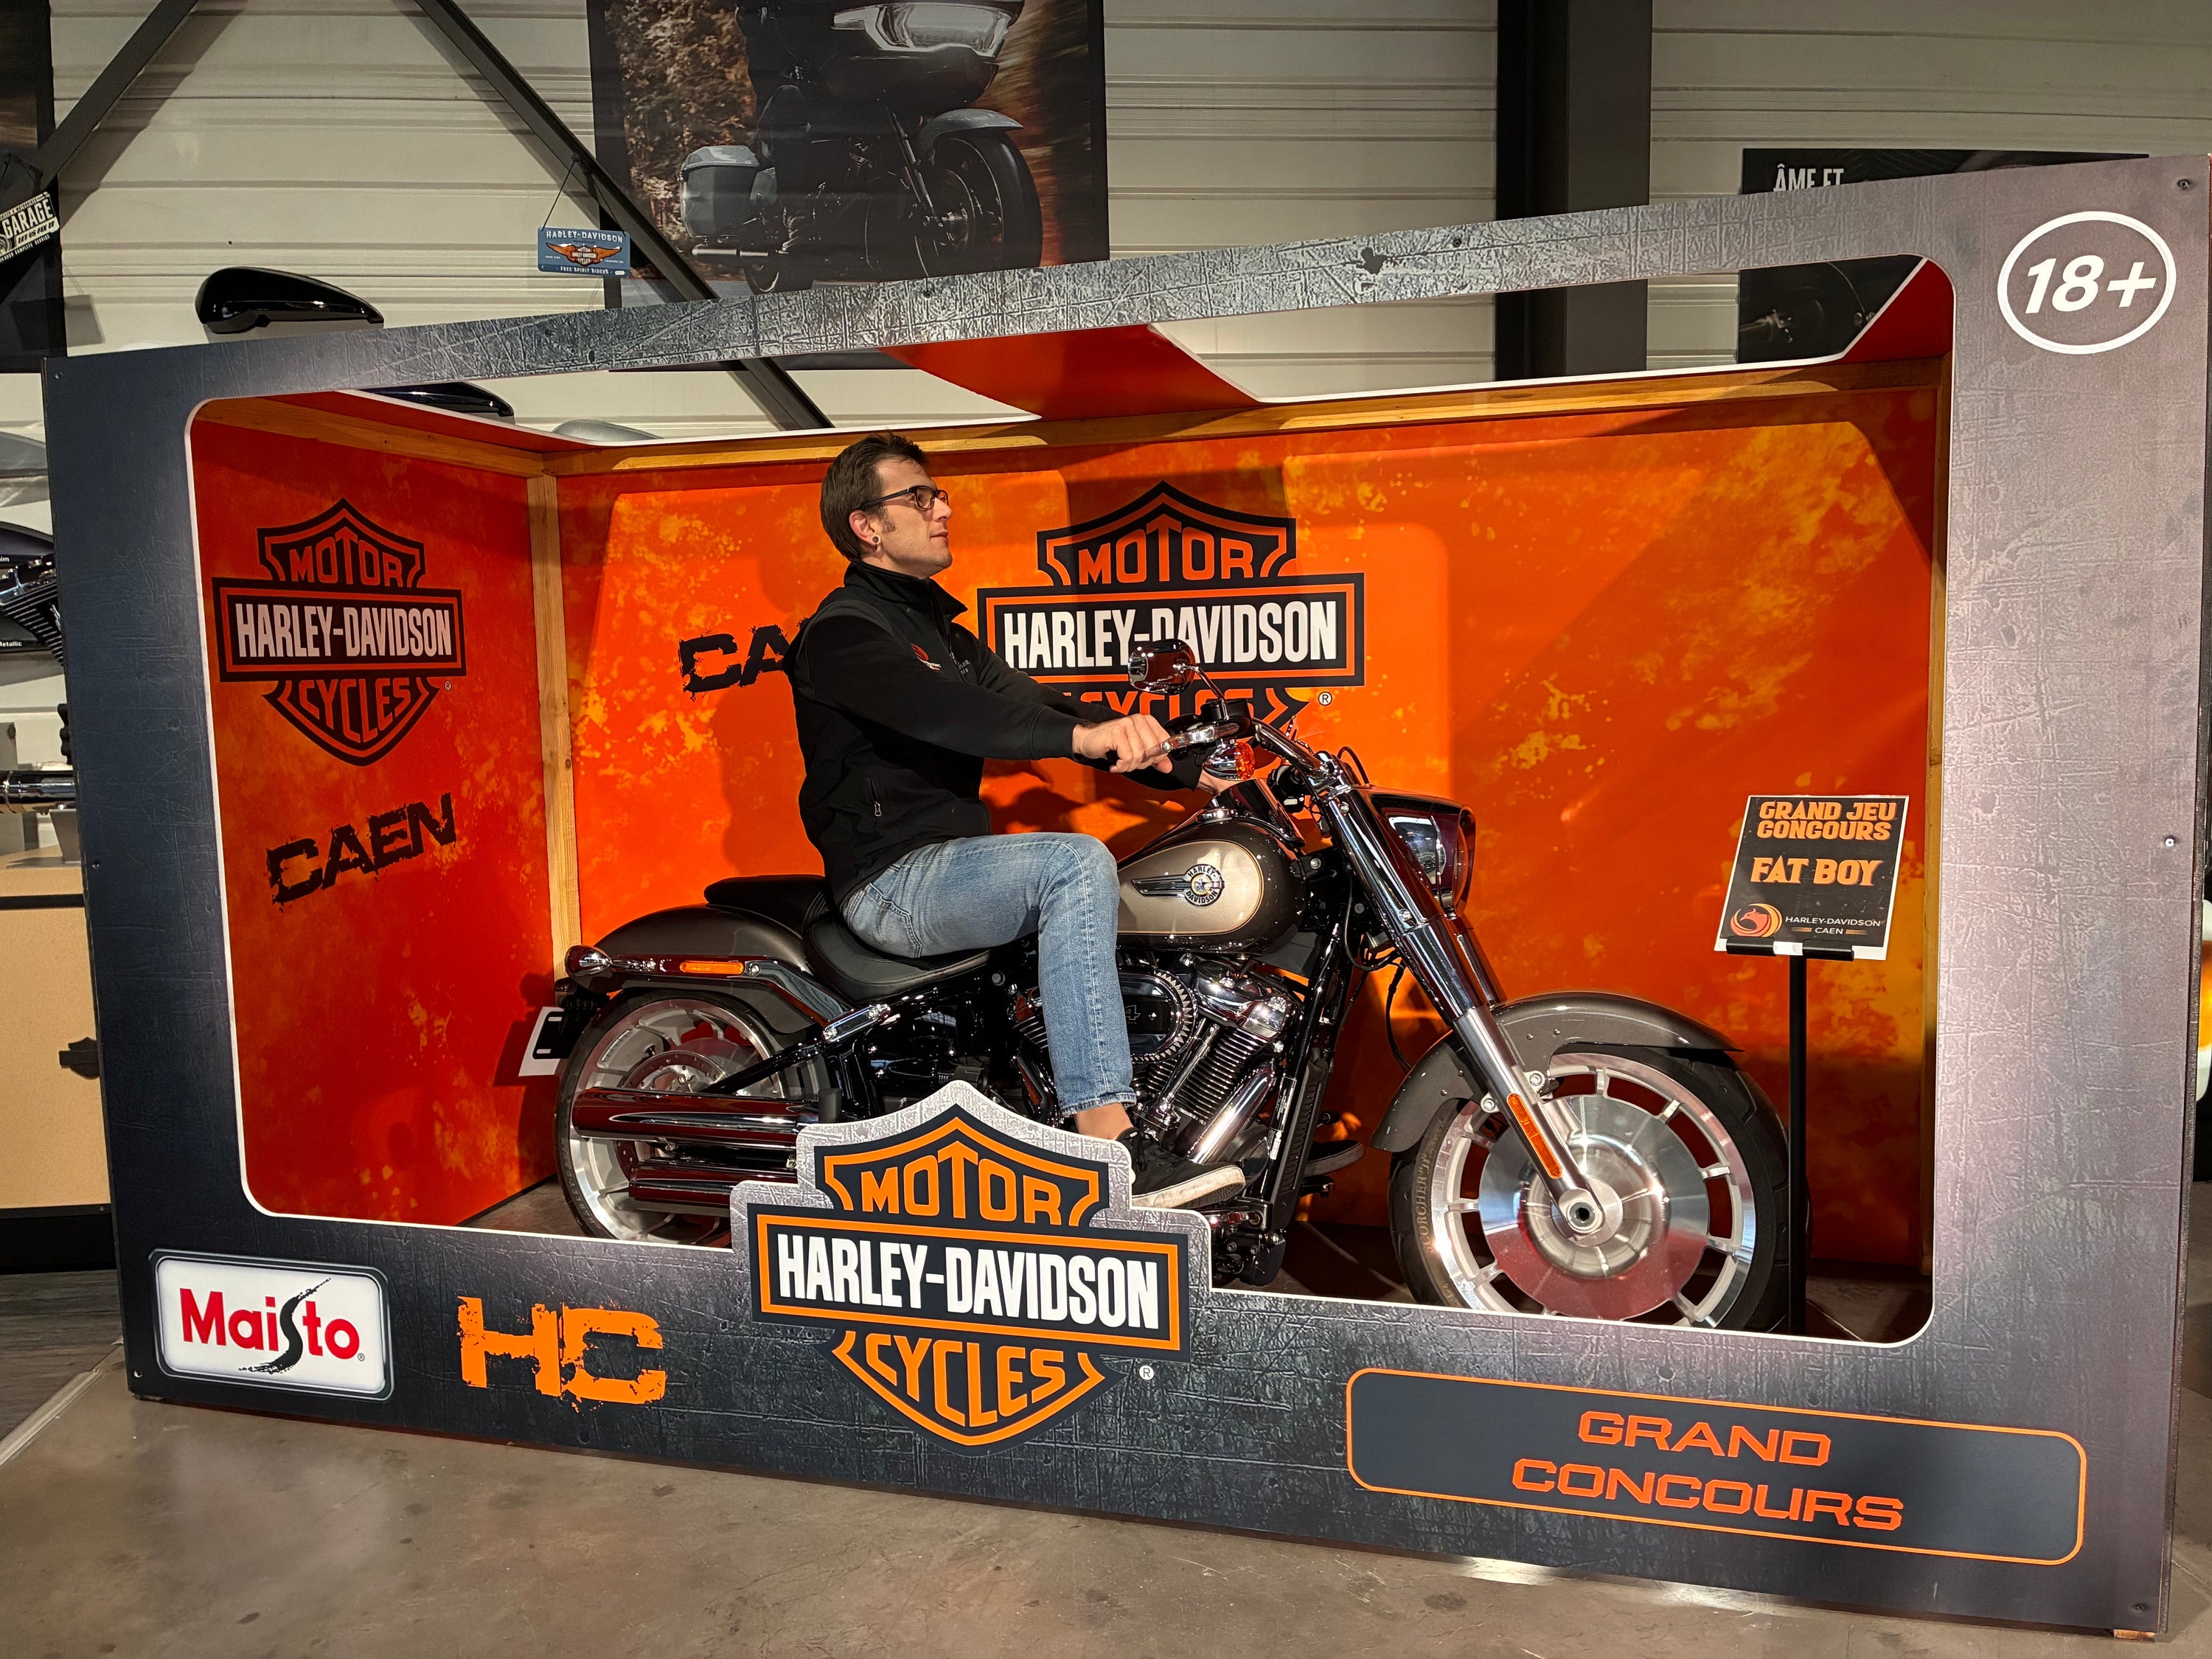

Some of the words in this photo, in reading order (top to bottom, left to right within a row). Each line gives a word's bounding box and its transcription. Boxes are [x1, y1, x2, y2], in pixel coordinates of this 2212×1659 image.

[1773, 163, 1817, 192] ÂME
[1823, 168, 1845, 187] ET
[2, 198, 53, 239] GARAGE
[546, 230, 623, 243] HARLEY-DAVIDSON
[2025, 255, 2157, 314] 18+
[289, 526, 403, 588] MOTOR
[1078, 513, 1253, 585] MOTOR
[235, 603, 452, 658] HARLEY-DAVIDSON
[678, 618, 800, 700] CA
[299, 677, 411, 744] CYCLES
[1756, 820, 1892, 841] CONCOURS
[1759, 800, 1843, 821] GRAND
[1846, 801, 1898, 821] JEU
[266, 792, 457, 910] CAEN
[1187, 866, 1217, 877] HARLEY-
[1750, 855, 1809, 884] FAT
[1813, 858, 1884, 886] BOY
[1186, 890, 1219, 904] DAVIDSON
[1785, 916, 1881, 927] HARLEY-DAVIDSON
[1815, 927, 1843, 935] CAEN
[860, 1140, 1062, 1226] MOTOR
[776, 1233, 1160, 1329] HARLEY-DAVIDSON
[456, 1295, 668, 1405] HC
[865, 1334, 1066, 1428] CYCLES
[1578, 1411, 1832, 1467] GRAND
[1512, 1458, 1905, 1531] CONCOURS
